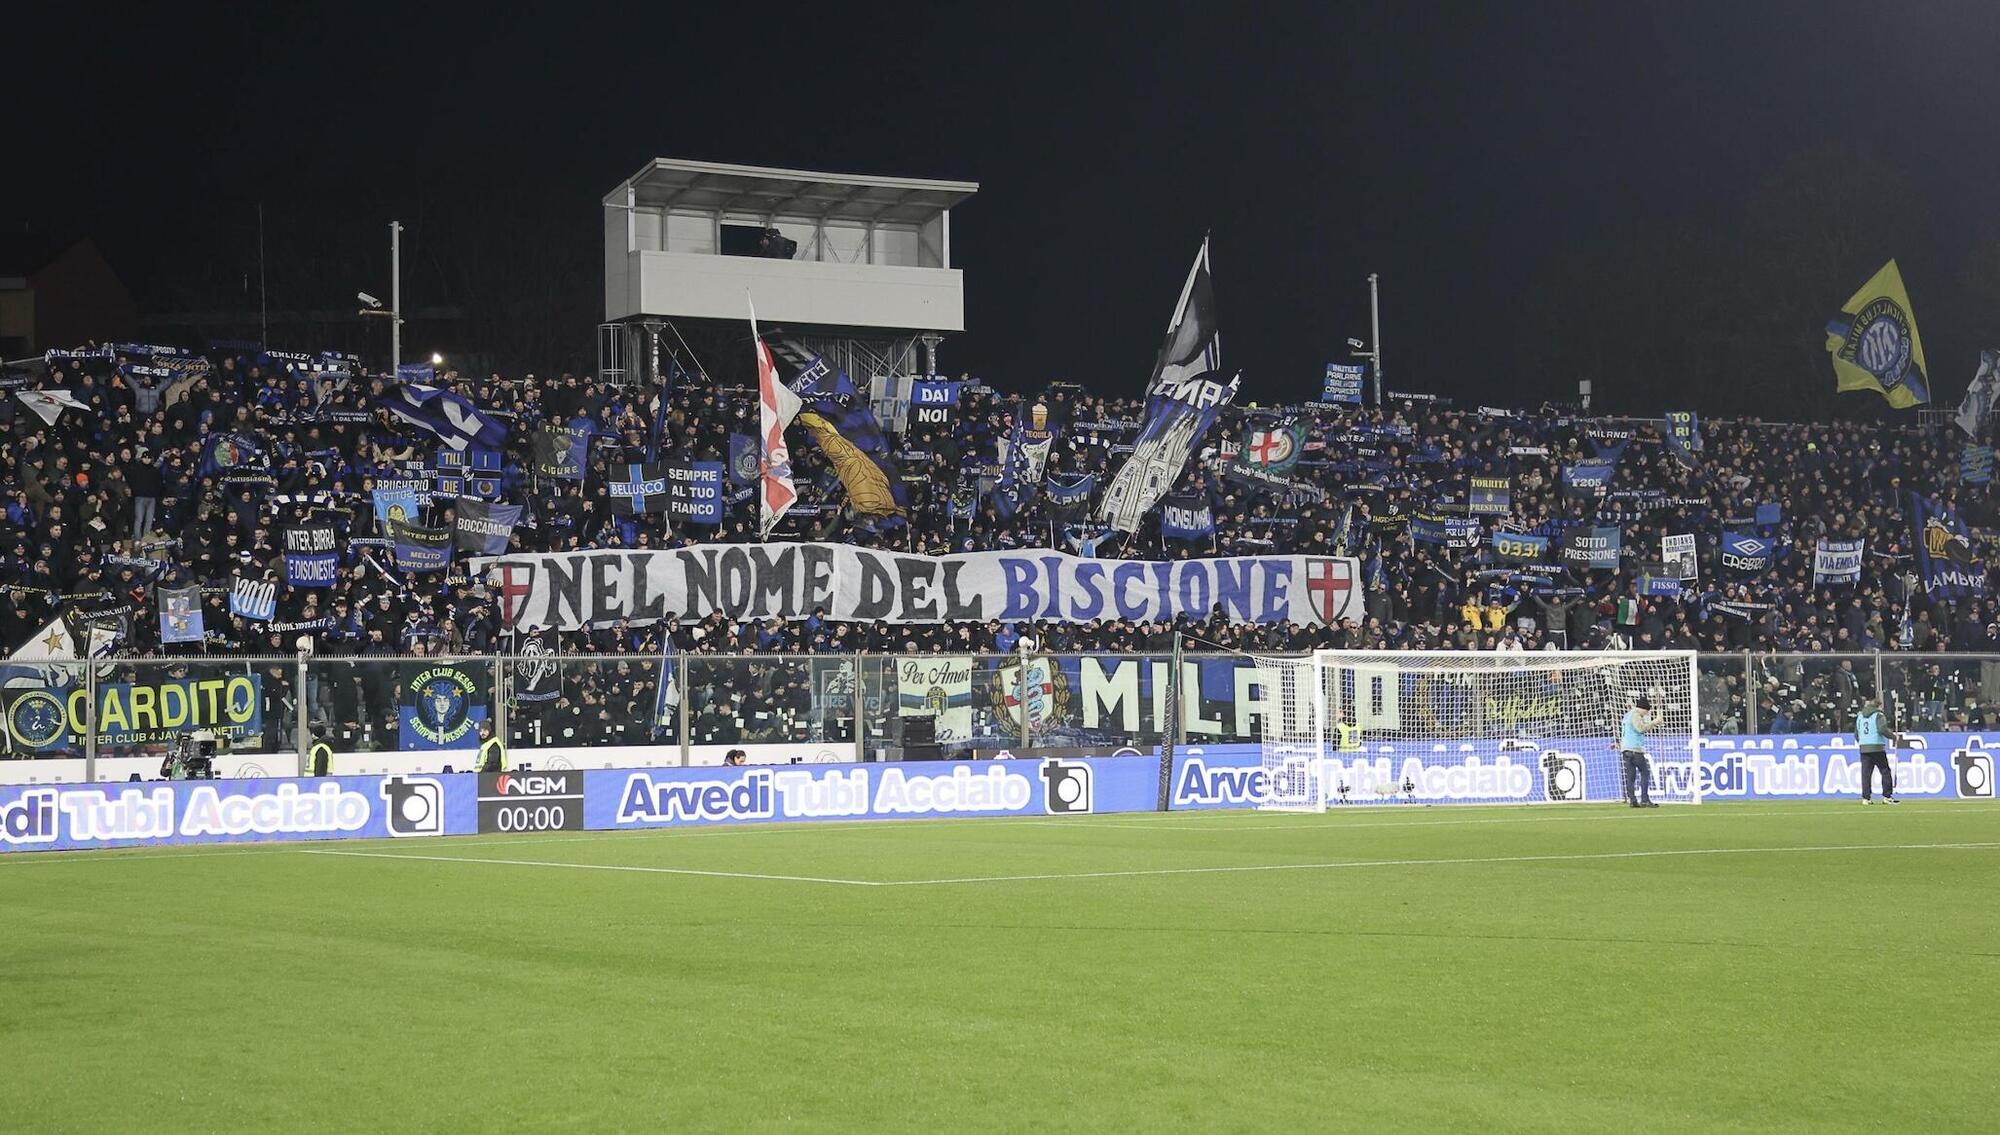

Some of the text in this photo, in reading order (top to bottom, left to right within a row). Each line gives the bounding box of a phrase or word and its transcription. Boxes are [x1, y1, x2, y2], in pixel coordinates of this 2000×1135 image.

[132, 365, 169, 377] 22:43
[921, 388, 949, 402] DAI
[918, 409, 948, 422] NOI
[545, 425, 585, 438] FINALE
[1589, 430, 1628, 439] MILANO
[1336, 434, 1365, 443] INTER
[406, 461, 424, 469] INTER
[541, 464, 579, 475] LIGURE
[668, 468, 717, 482] SEMPRE
[443, 480, 459, 492] DIE
[611, 481, 663, 495] BELLUSCO
[1471, 478, 1509, 488] TORRITA
[1572, 478, 1602, 487] F205
[671, 485, 715, 498] AL TUO
[671, 502, 715, 515] FIANCO
[1470, 503, 1509, 512] PRESENTE
[313, 528, 335, 549] BIRRA
[429, 533, 450, 541] CLUB
[1575, 536, 1607, 548] SOTTO
[1666, 536, 1693, 546] INDIANS
[1564, 547, 1617, 560] PRESSIONE
[1722, 553, 1766, 570] CASBRO
[1819, 555, 1834, 569] VIA
[290, 558, 335, 580] E DISONESTE
[1529, 564, 1562, 573] MILANO
[544, 544, 1293, 626] NEL NOME DEL BISCIONE
[1652, 580, 1677, 589] FISSO
[900, 661, 970, 685] Per Amor
[411, 668, 476, 694] INTER CLUB SESSO
[67, 676, 255, 734] CARDITO
[410, 717, 438, 743] SEMPRE
[1863, 722, 1870, 735] 3
[116, 732, 147, 743] CLUB
[149, 732, 156, 742] 4
[1179, 757, 1531, 800] Arvedi Tubi Acciaio
[1751, 755, 1816, 793] Tubi
[504, 776, 566, 795] NGM
[622, 766, 1029, 817] Arvedi Tubi Acciaio
[65, 791, 171, 838] Tubi
[186, 785, 366, 833] Acciaio
[498, 806, 565, 832] 00:00
